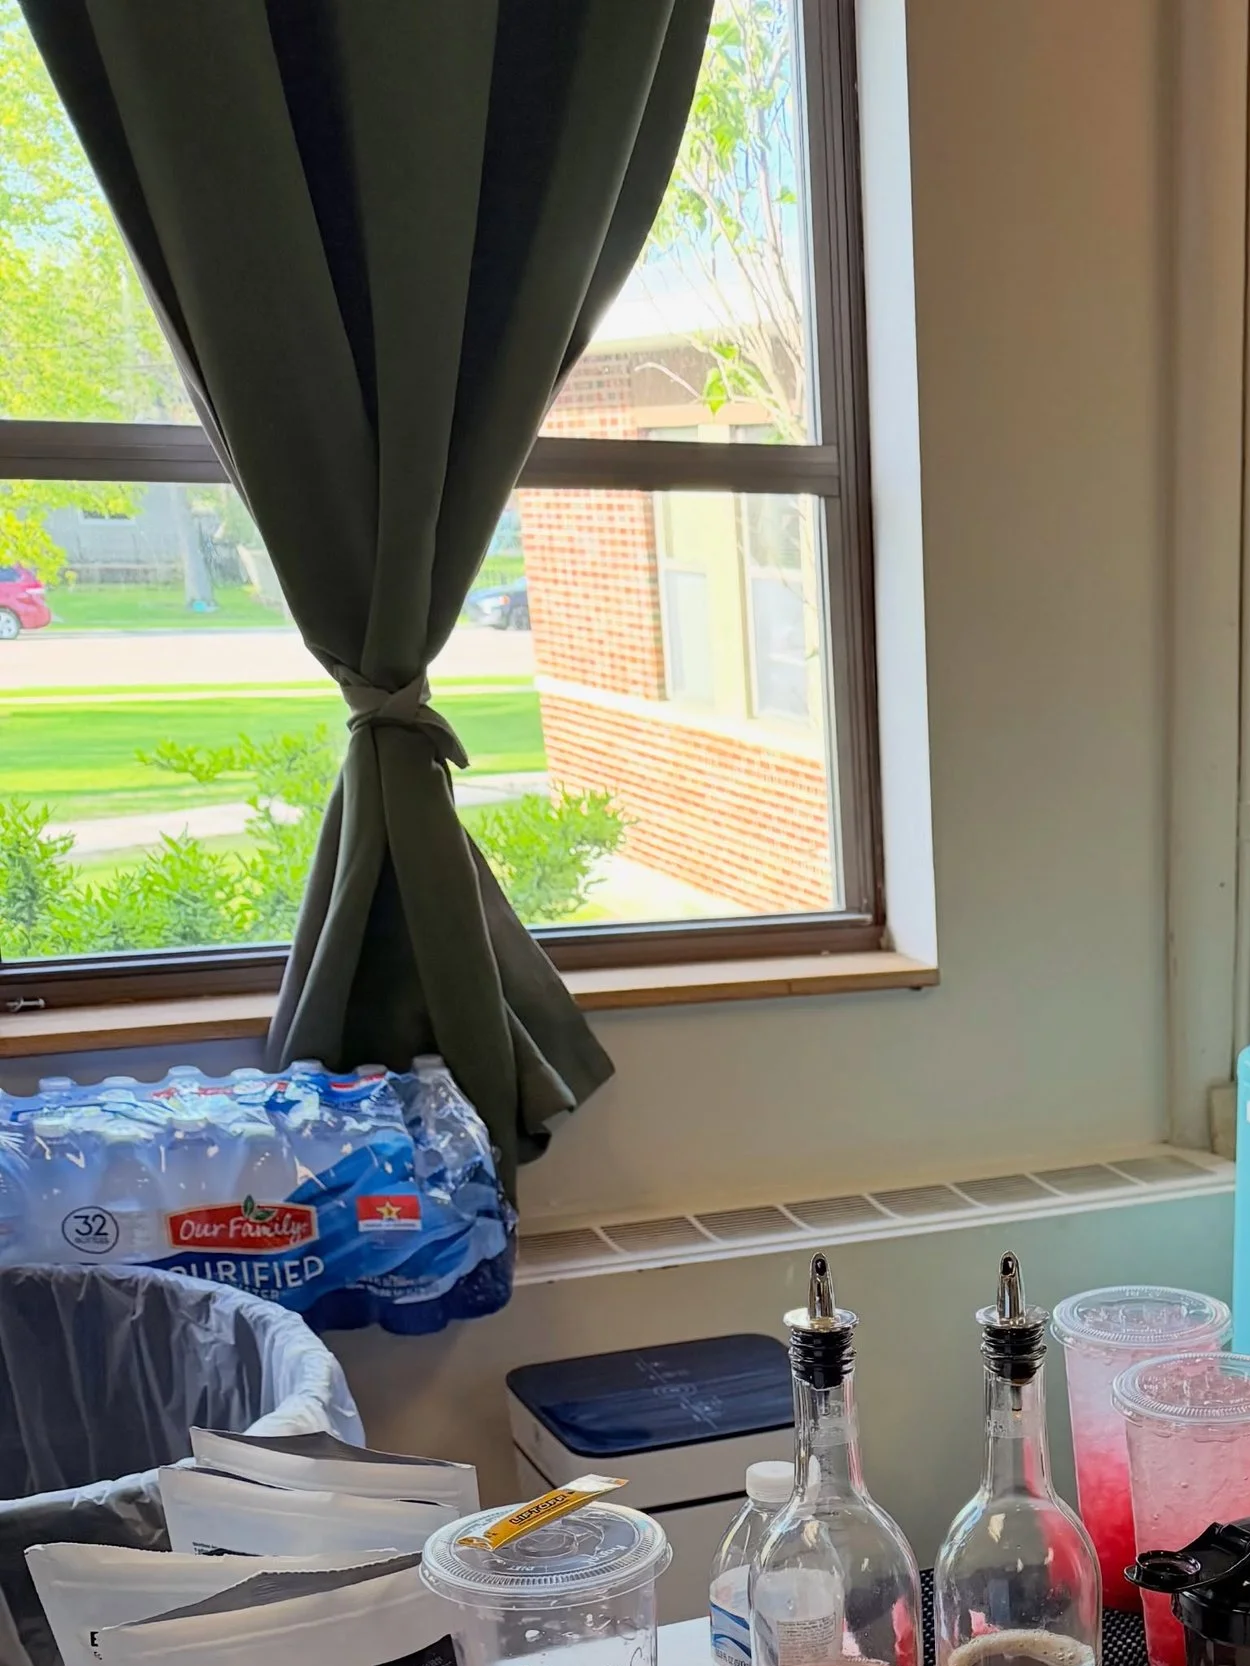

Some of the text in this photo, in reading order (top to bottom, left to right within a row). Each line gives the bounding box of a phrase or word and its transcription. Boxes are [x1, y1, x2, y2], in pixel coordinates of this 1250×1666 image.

[74, 1214, 109, 1236] 32
[179, 1211, 305, 1245] Our Family
